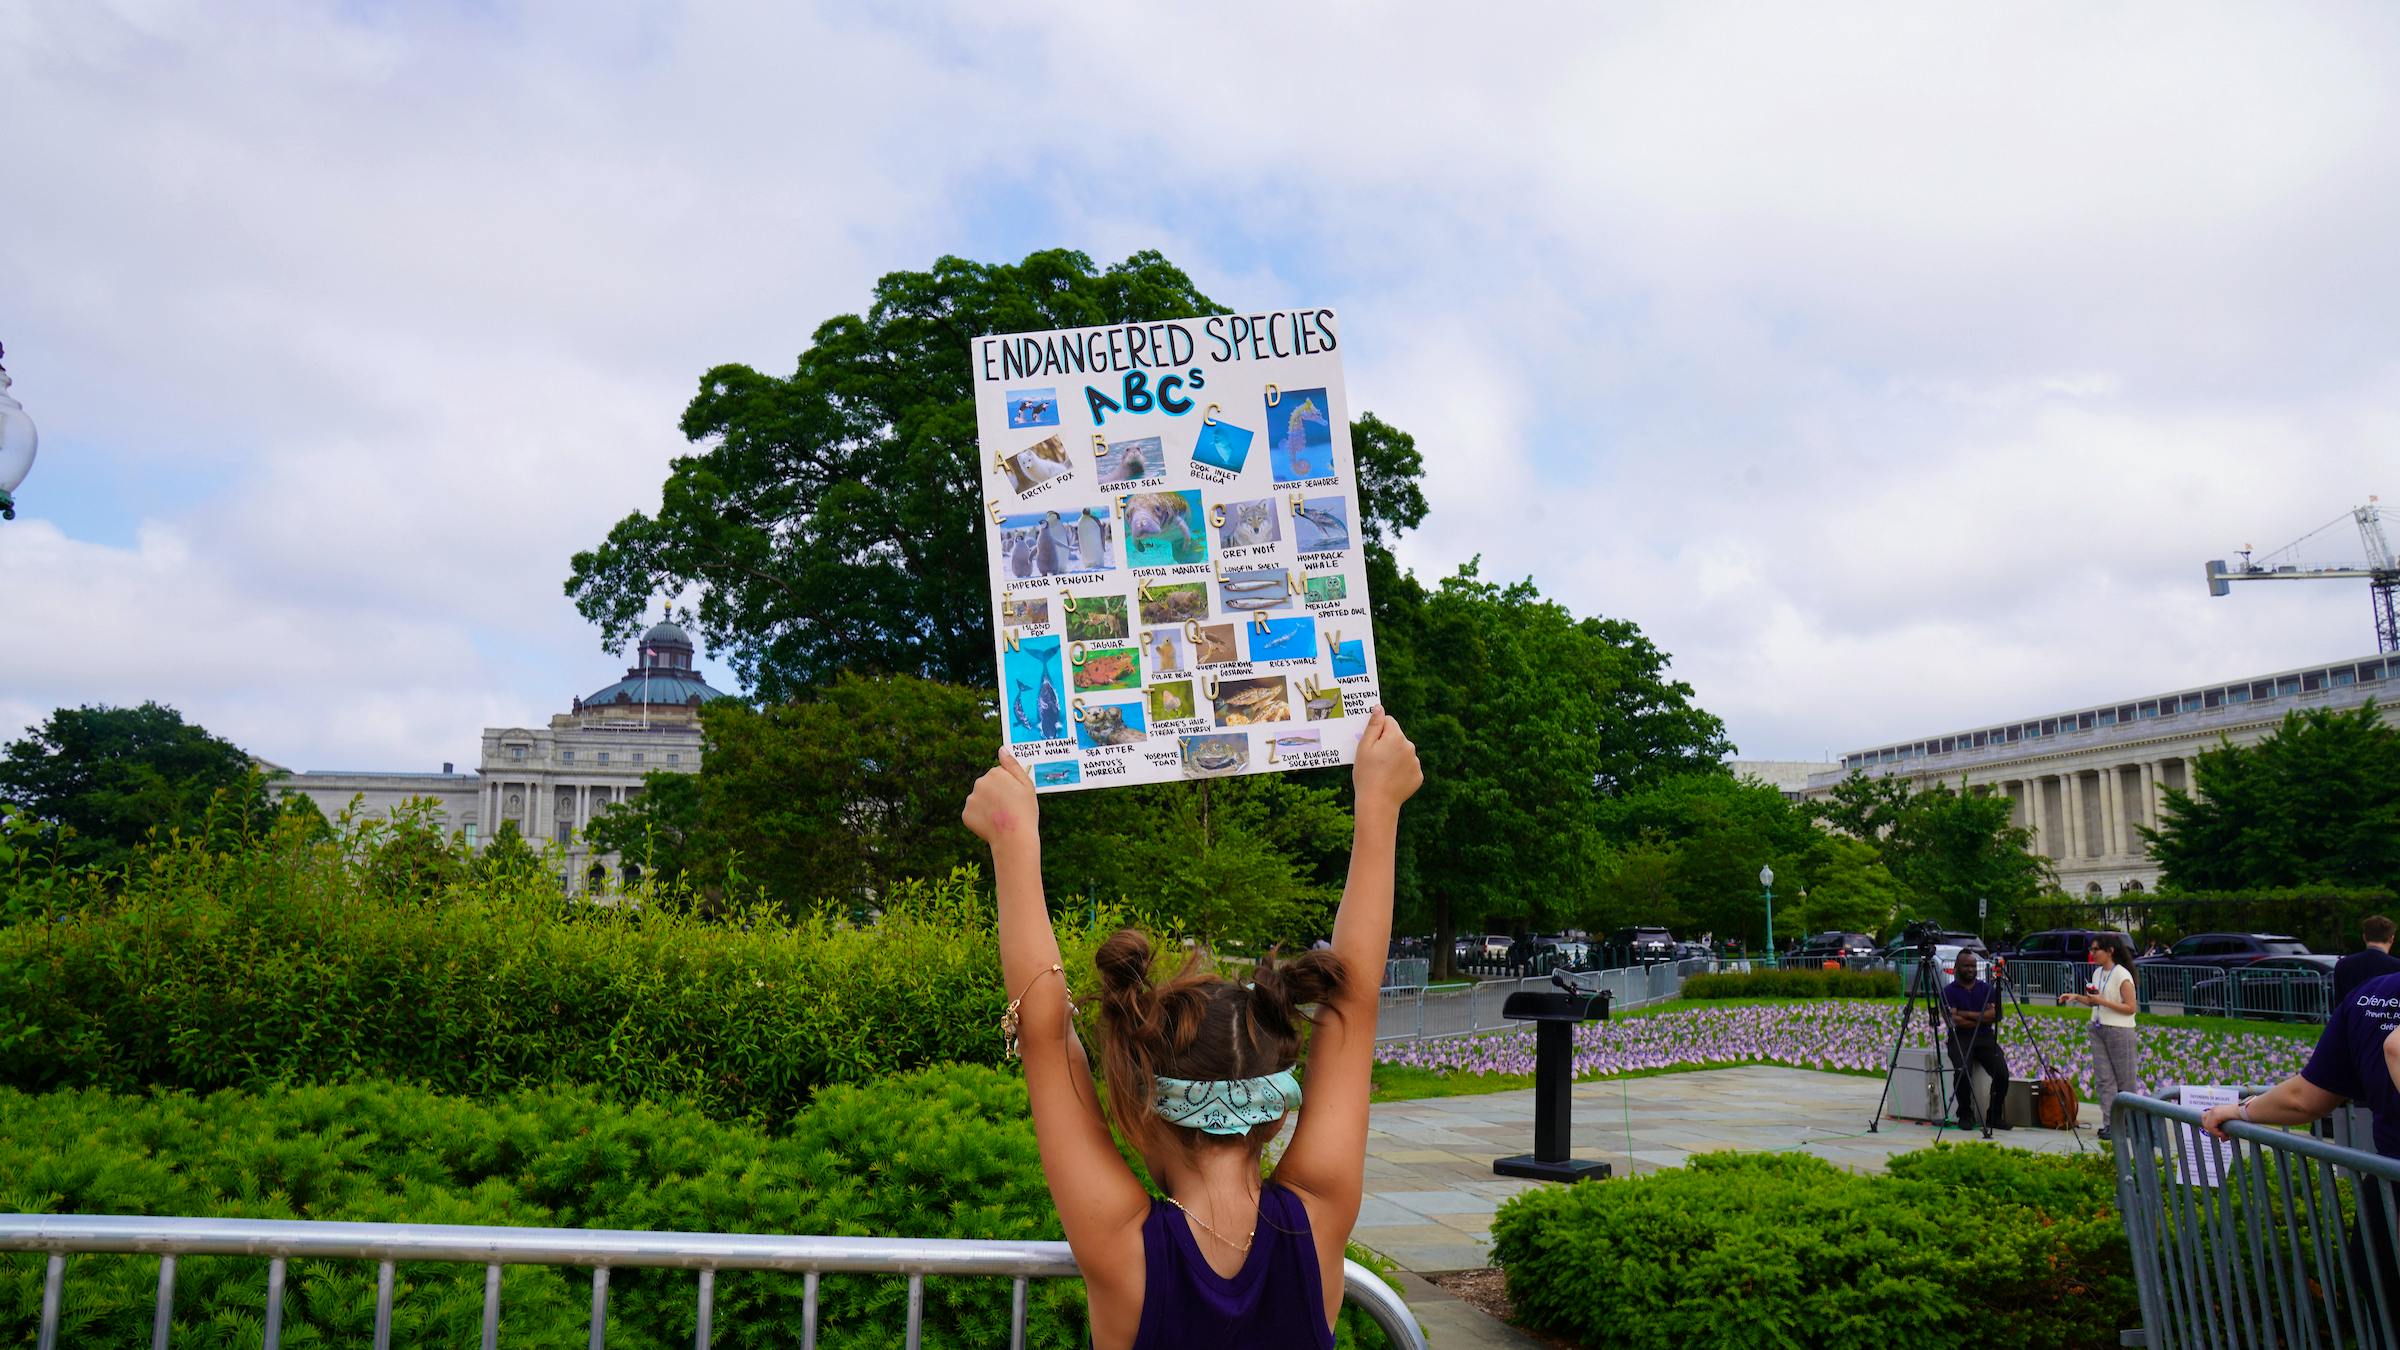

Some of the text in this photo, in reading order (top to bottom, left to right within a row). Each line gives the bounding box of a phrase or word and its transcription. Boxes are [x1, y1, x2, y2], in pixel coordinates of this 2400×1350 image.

[983, 309, 1337, 381] ENDANGERED SPECIES
[1265, 383, 1281, 407] D
[1203, 403, 1220, 426] C
[1091, 433, 1109, 457] B
[993, 449, 1012, 474] A
[1190, 461, 1238, 481] COOK INLET
[1021, 472, 1074, 501] ARCTIC FOX
[1100, 478, 1164, 493] BEARDED SEAL
[1190, 470, 1224, 485] BELUGA
[1273, 477, 1339, 491] DWARF SEAHORSE
[987, 499, 1006, 525] E
[1115, 494, 1127, 519] F
[1210, 503, 1226, 528] G
[1289, 493, 1305, 517] H
[1222, 550, 1247, 560] GREY
[1297, 551, 1344, 562] HUMPBACK
[1304, 560, 1339, 570] WHALE
[1133, 565, 1211, 578] FLORIDA MANATEE
[1215, 560, 1230, 583] L
[1224, 562, 1280, 573] LONGFIN SMELT
[1006, 574, 1104, 591] EMPEROR PENGUIN
[1138, 577, 1154, 601] K
[1286, 570, 1308, 596] M
[1002, 592, 1014, 616] I
[1060, 588, 1077, 613] J
[1305, 601, 1341, 610] MEXICAN
[1253, 610, 1271, 635] R
[1318, 607, 1366, 618] SPOTTED OWL
[1022, 623, 1051, 631] ISLAND
[1185, 617, 1203, 644] Q
[1003, 628, 1019, 653] N
[1091, 640, 1125, 650] JAGUAR
[1140, 631, 1153, 656] P
[1324, 630, 1341, 655] V
[1070, 640, 1087, 666] O
[1269, 659, 1291, 668] RICE'S
[1175, 671, 1194, 679] BEAR
[1220, 669, 1254, 677] GOSHAWK
[1337, 676, 1370, 685] VAQUITA
[1202, 674, 1220, 701] U
[1294, 673, 1321, 702] W
[1343, 690, 1378, 700] WESTERN
[1072, 698, 1087, 722] S
[1142, 687, 1155, 714] T
[1344, 700, 1364, 708] POND
[1344, 706, 1374, 716] TURTLE
[1178, 725, 1211, 735] BUTTERFLY
[1012, 743, 1041, 752] NORTH
[1014, 750, 1040, 758] RIGHT
[1085, 745, 1135, 757] SEA OTTER
[1178, 737, 1191, 764] Y
[1265, 739, 1280, 765] Z
[1085, 766, 1127, 778] MURRELET
[1288, 757, 1341, 768] SUCKER FISH
